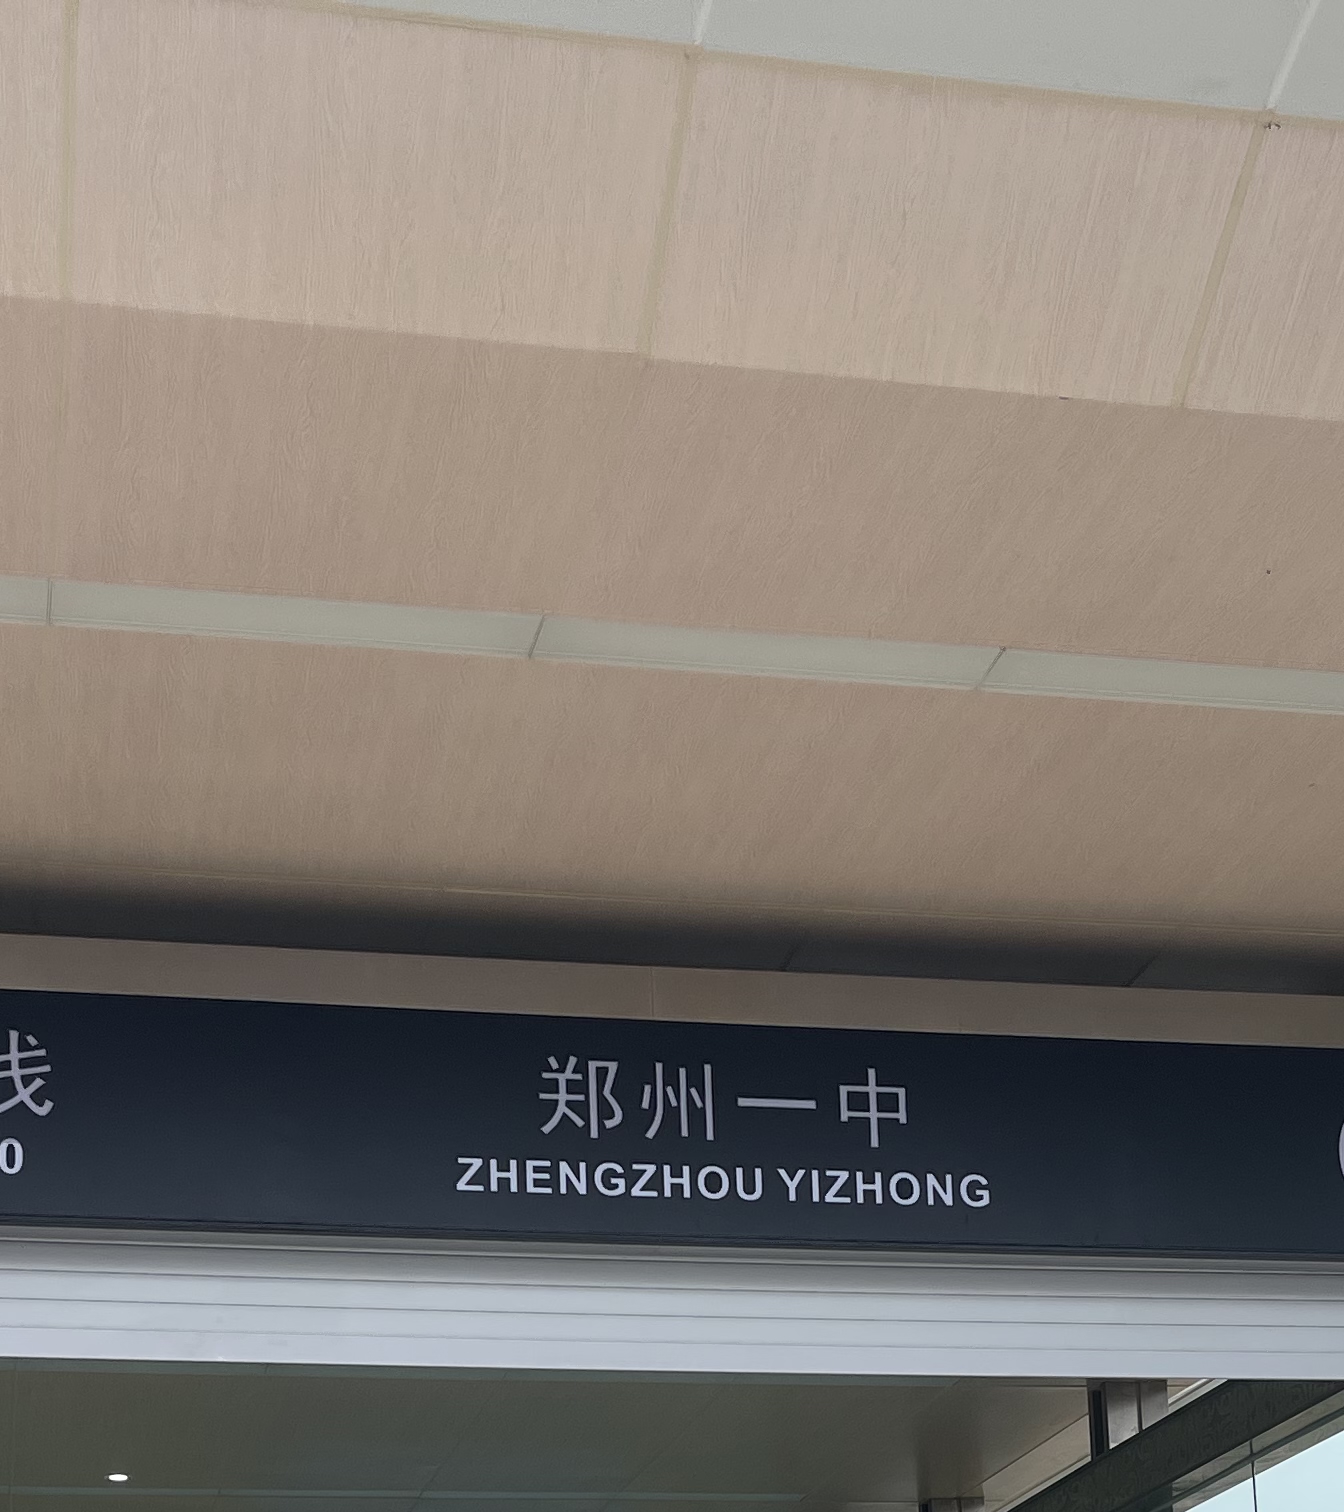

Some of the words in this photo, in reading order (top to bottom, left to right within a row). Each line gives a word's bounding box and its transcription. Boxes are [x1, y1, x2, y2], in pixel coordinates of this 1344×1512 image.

[539, 1055, 908, 1148] 郑州一中
[456, 1157, 763, 1201] ZHENGZHOU
[776, 1168, 991, 1208] YIZHONG
